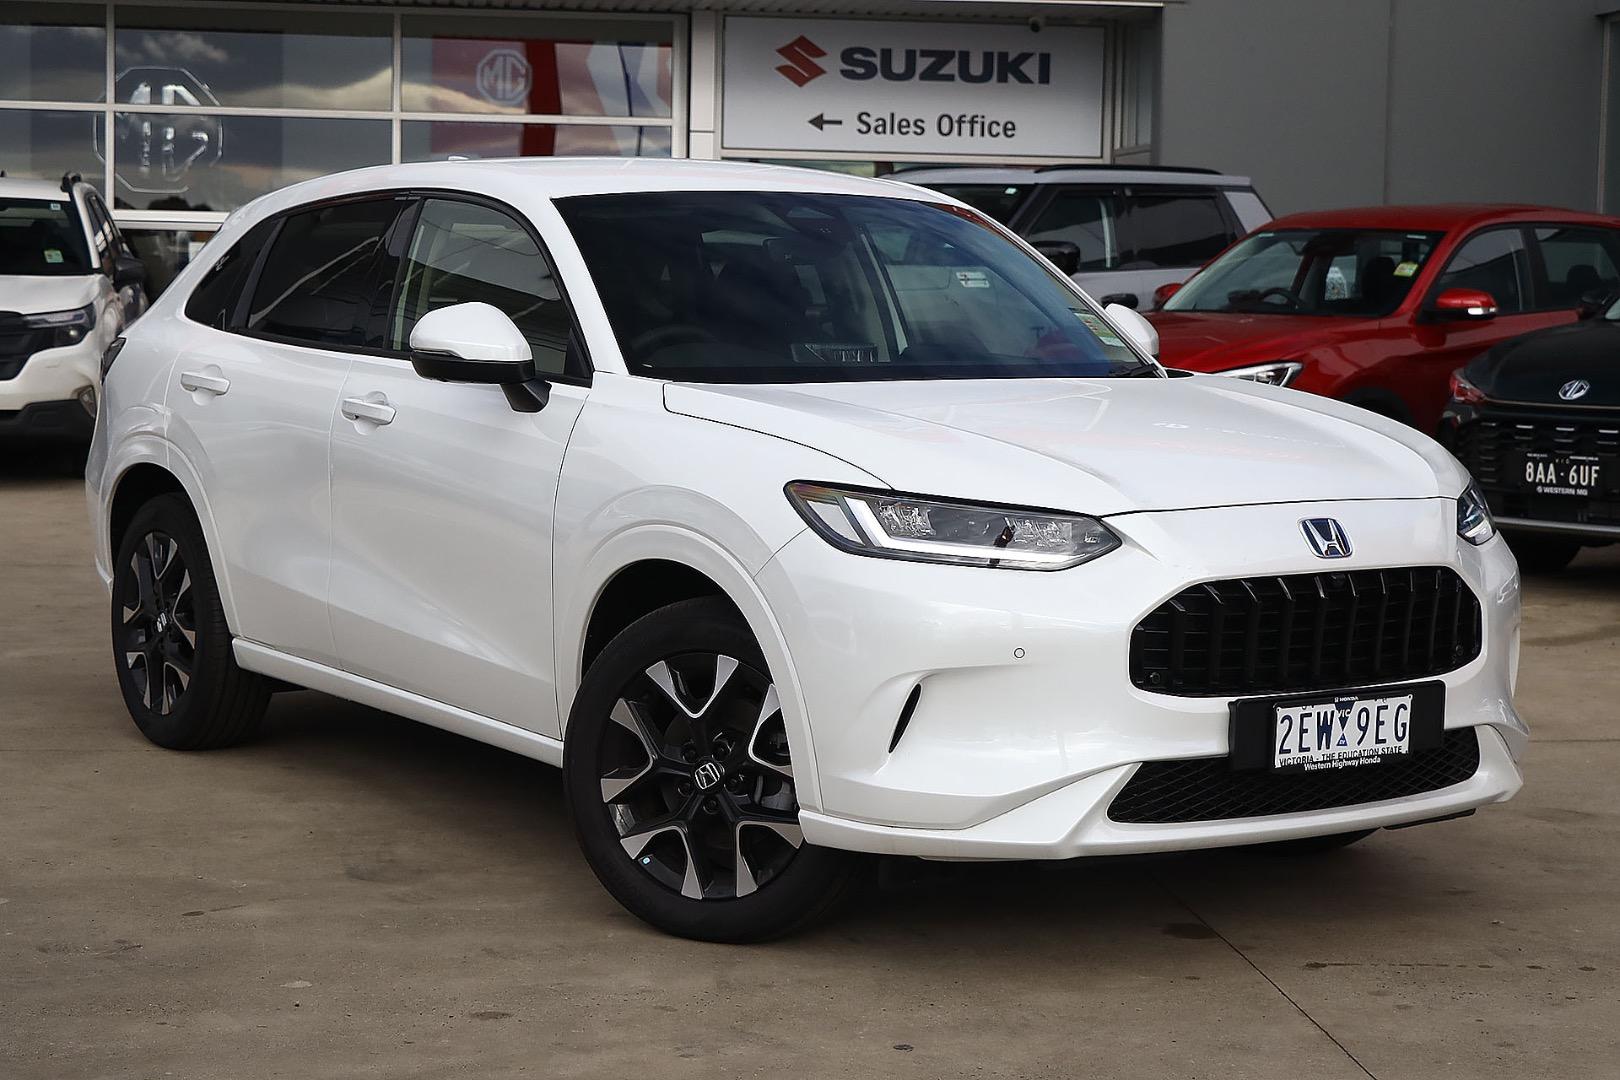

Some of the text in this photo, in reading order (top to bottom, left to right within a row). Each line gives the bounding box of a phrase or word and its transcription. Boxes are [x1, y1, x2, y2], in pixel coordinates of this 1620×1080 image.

[840, 47, 1050, 84] SUZUKI
[856, 111, 1016, 138] Sales Office
[1543, 487, 1576, 495] WESTERN
[1279, 754, 1314, 766] VICTORIA
[1322, 752, 1336, 761] THE
[1337, 747, 1380, 759] EDUCATION
[1381, 745, 1403, 755] STATE
[1304, 756, 1381, 771] Western Highway Honda
